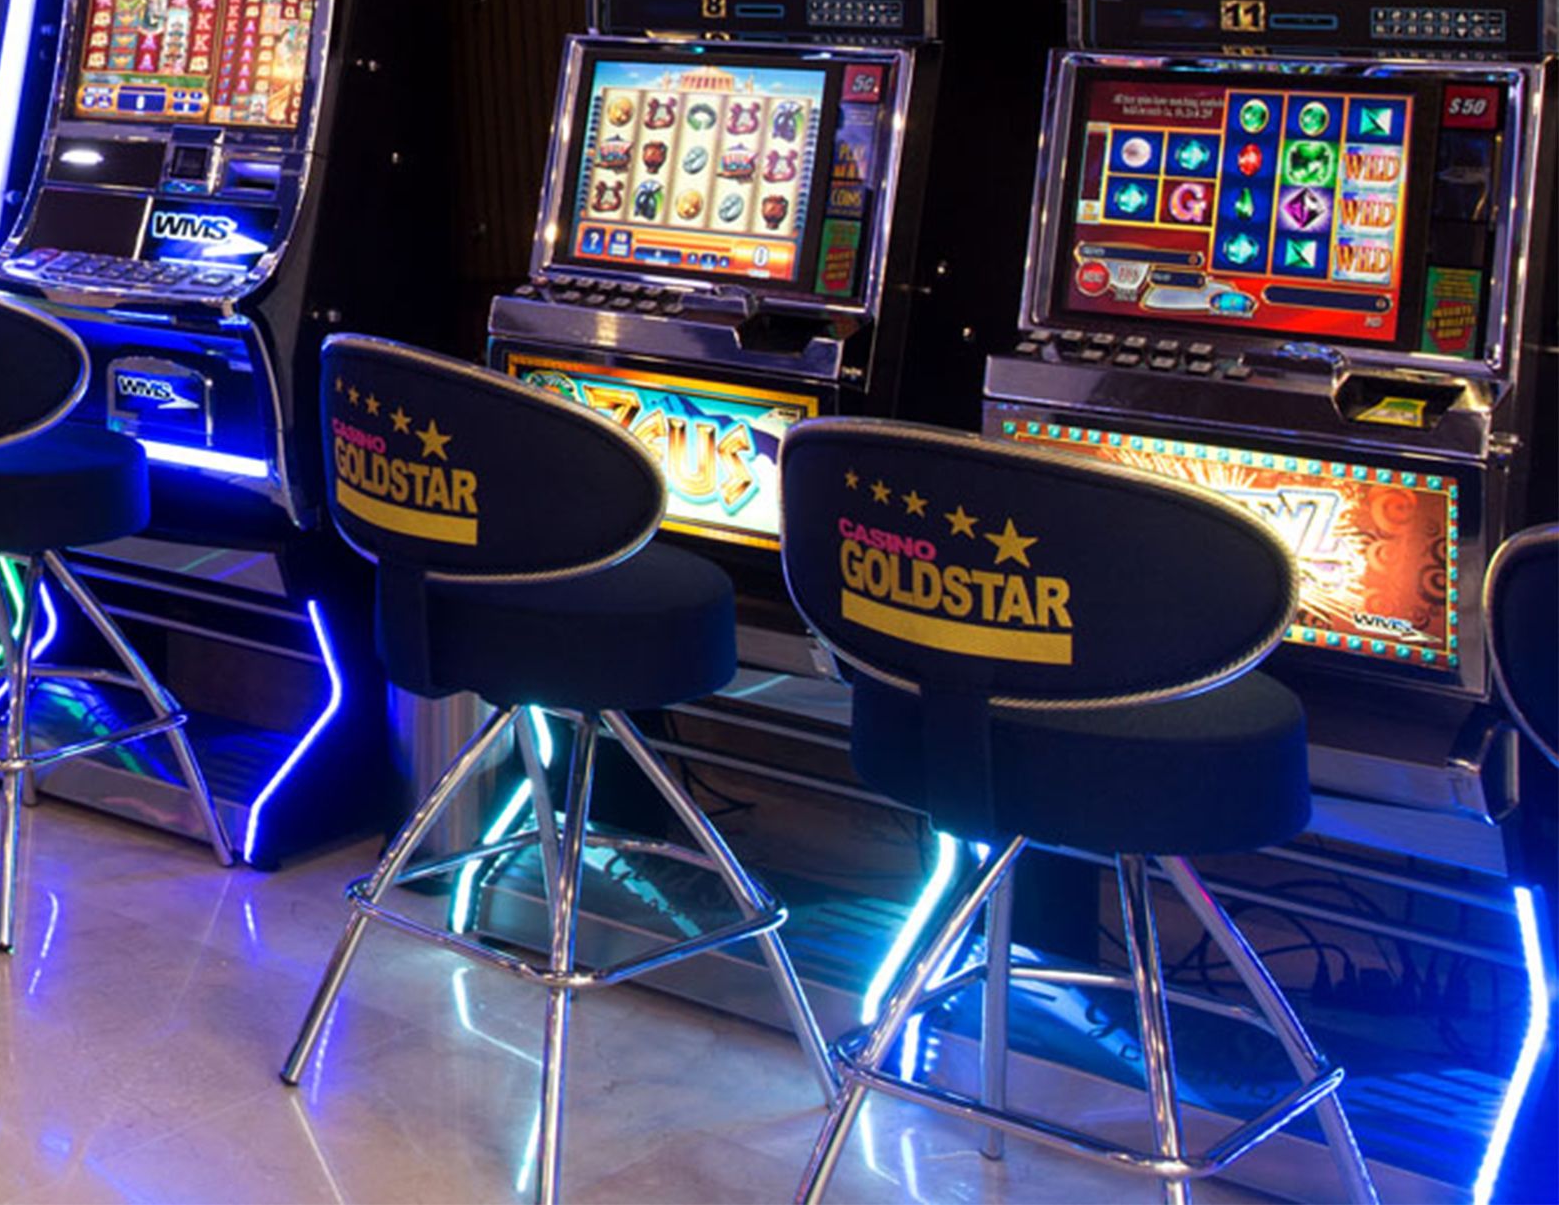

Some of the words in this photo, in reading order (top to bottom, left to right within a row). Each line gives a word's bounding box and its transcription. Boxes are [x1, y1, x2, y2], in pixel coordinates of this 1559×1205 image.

[1223, 2, 1261, 27] 11
[1342, 154, 1401, 182] WILD
[1169, 182, 1207, 223] G
[1338, 198, 1396, 229] WILD
[153, 214, 231, 240] WMS
[1334, 245, 1392, 275] WILD
[118, 376, 172, 400] WMS
[332, 417, 387, 455] CASINO
[334, 438, 478, 513] GOLDSTAR
[840, 517, 937, 561] CASINO
[840, 541, 1074, 628] GOLDSTAR
[1353, 611, 1414, 636] WMS
